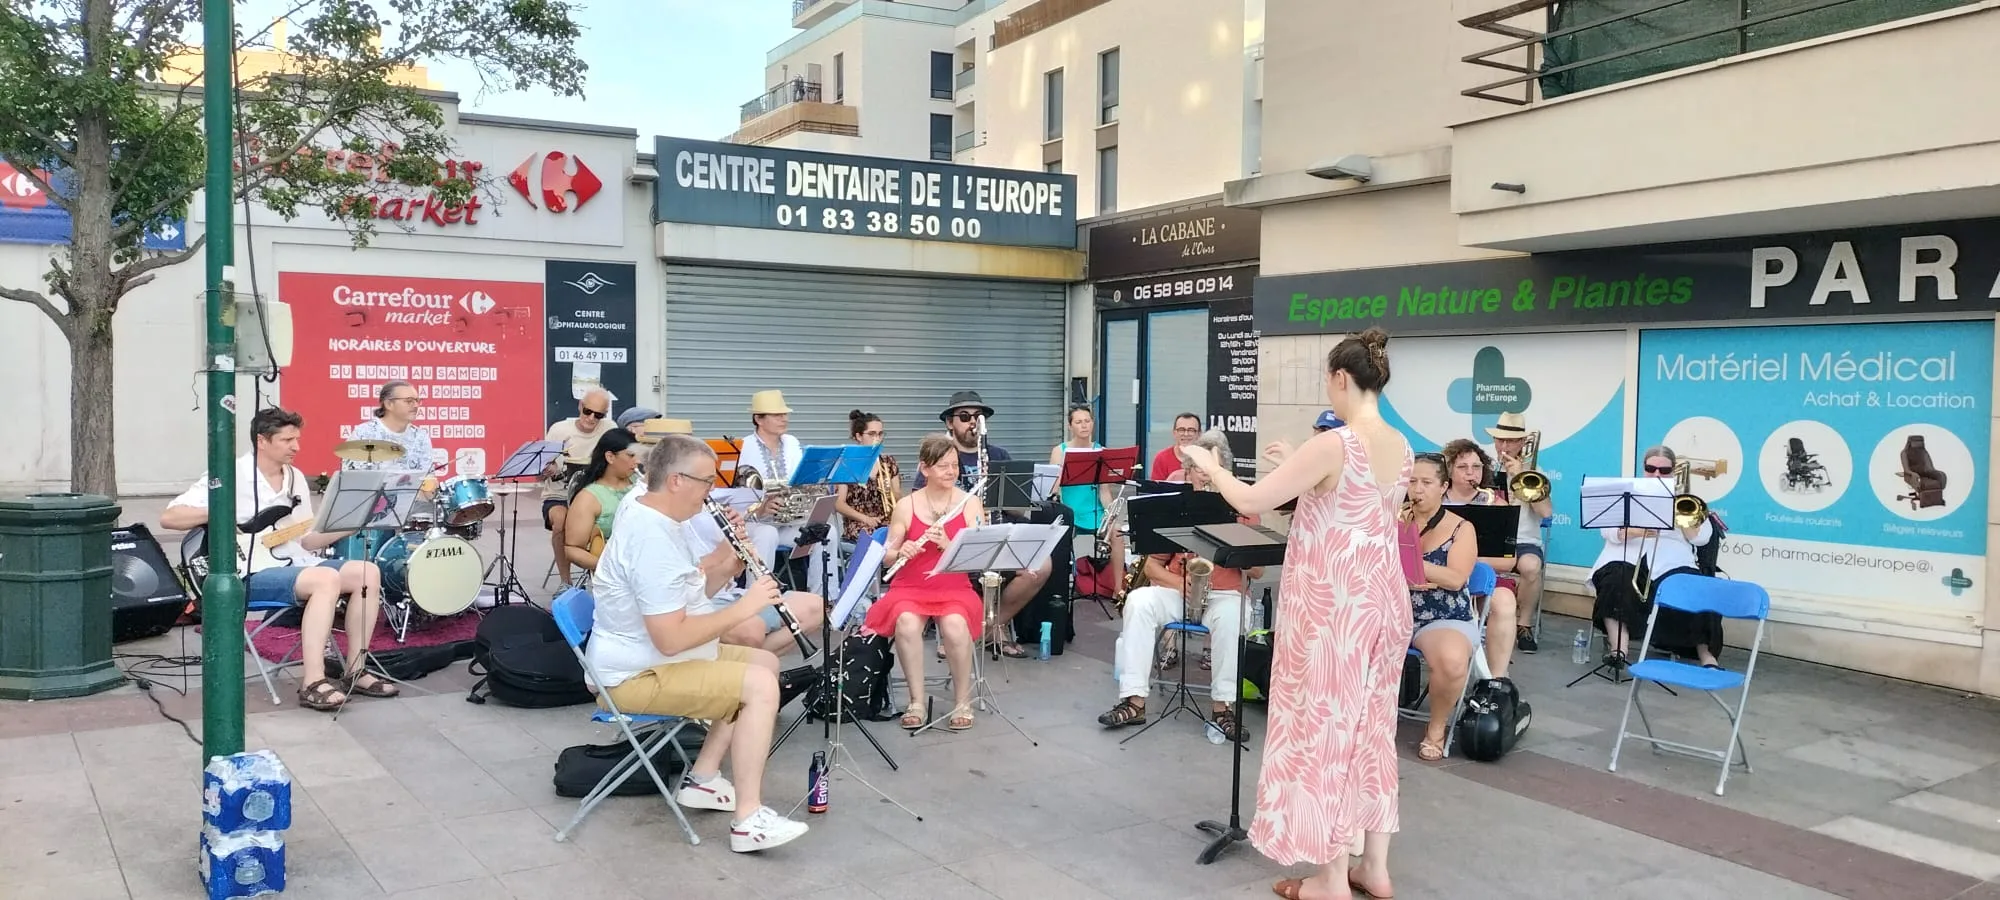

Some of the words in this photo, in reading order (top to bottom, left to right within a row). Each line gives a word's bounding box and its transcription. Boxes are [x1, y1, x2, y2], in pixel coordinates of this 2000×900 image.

[675, 150, 775, 194] CENTRE
[786, 160, 899, 204] DENTAIRE
[911, 171, 940, 207] DE
[952, 175, 1062, 216] L'EUROPE
[777, 204, 808, 227] 01
[822, 208, 855, 230] 83
[867, 211, 898, 233] 38
[910, 215, 940, 236] 50
[951, 217, 981, 238] 00
[1141, 227, 1157, 245] LA
[1161, 217, 1215, 242] CABANE
[1134, 285, 1151, 300] 06
[1154, 282, 1171, 298] 58
[1175, 280, 1193, 296] 98
[1196, 278, 1216, 294] 09
[1219, 276, 1234, 291] 14
[333, 285, 453, 309] Carrefour
[1288, 293, 1388, 327] Espace
[1397, 284, 1501, 317] Nature
[1511, 279, 1536, 312] &
[1548, 272, 1694, 309] Plantes
[385, 309, 452, 326] market
[575, 310, 605, 318] CENTRE
[557, 321, 626, 330] OPHTALMOLOGIQUE
[1218, 332, 1226, 340] Du
[1227, 331, 1243, 339] Lundi
[329, 338, 401, 352] HORAIRES
[405, 340, 496, 354] D'OUVERTURE
[559, 350, 570, 360] 01
[573, 351, 584, 360] 46
[586, 351, 597, 360] 49
[600, 351, 610, 361] 11
[613, 351, 624, 361] 99
[331, 366, 351, 377] DU
[357, 367, 407, 378] LUNDI
[413, 368, 432, 378] AU
[438, 368, 496, 379] SAMEDI
[1656, 352, 1788, 381] Matériel
[1800, 350, 1956, 382] Médical
[349, 386, 368, 397] DE
[433, 387, 480, 397] 20H30
[1476, 383, 1516, 392] Pharmacie
[1475, 393, 1485, 402] de
[1486, 393, 1518, 403] l'Europe
[1803, 391, 1860, 407] Achat
[1866, 391, 1881, 407] &
[1887, 391, 1975, 409] Location
[417, 408, 468, 418] ANCHE
[1210, 415, 1225, 432] LA
[445, 427, 484, 437] 9H00
[434, 546, 464, 558] TAMA
[1733, 542, 1753, 555] 60
